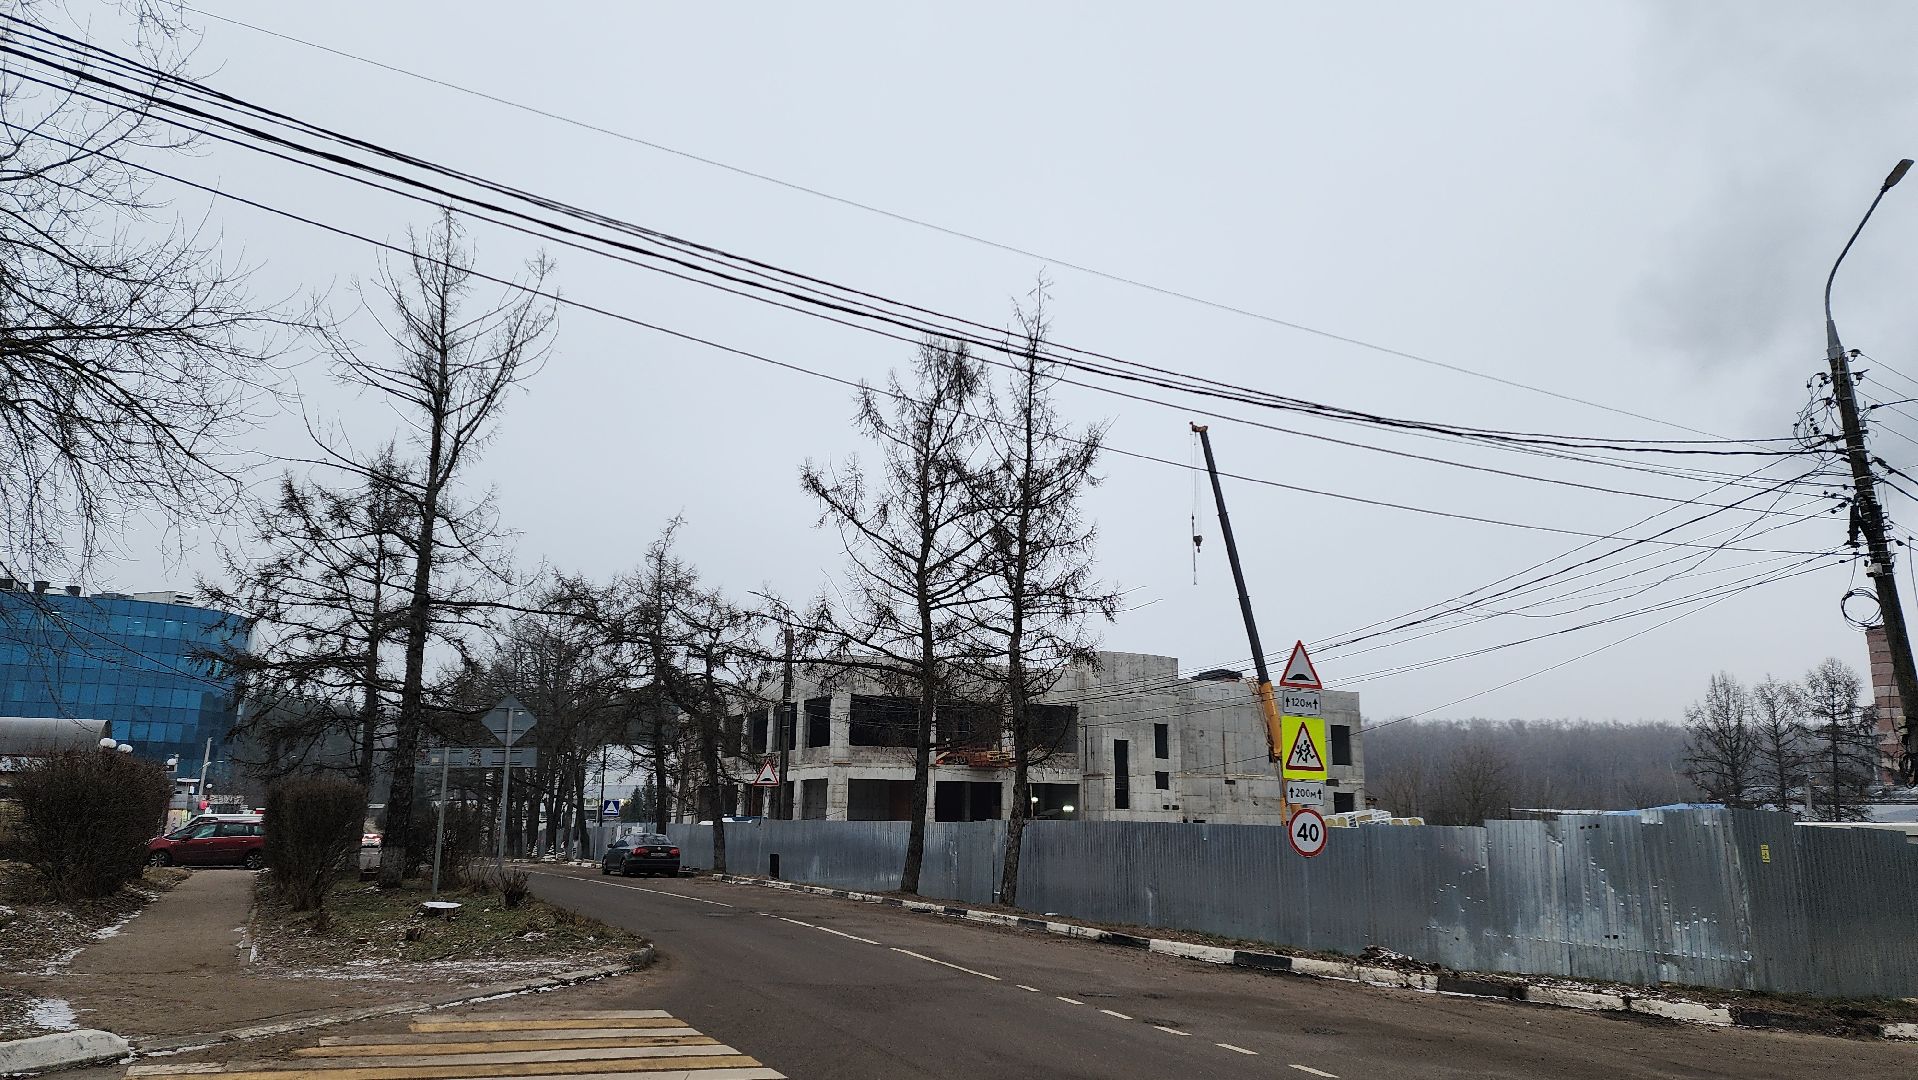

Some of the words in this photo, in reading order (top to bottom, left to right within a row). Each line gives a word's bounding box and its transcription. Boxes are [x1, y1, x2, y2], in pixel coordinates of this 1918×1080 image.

[1291, 697, 1312, 708] 120м
[1295, 787, 1317, 799] 200м
[1297, 822, 1320, 843] 40
